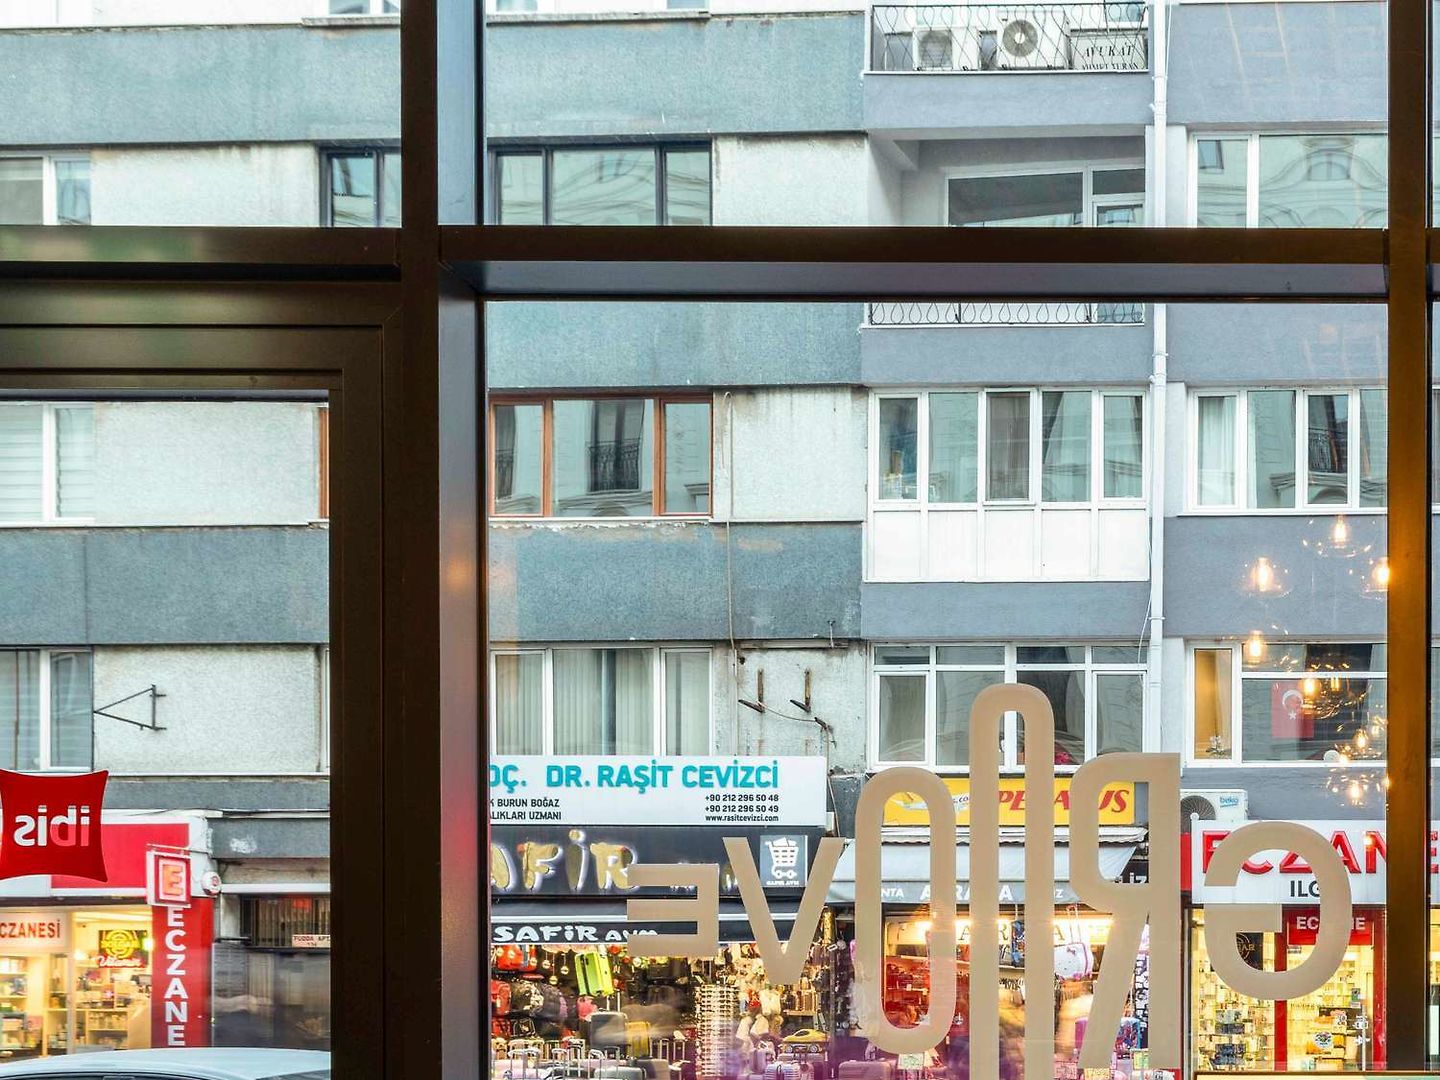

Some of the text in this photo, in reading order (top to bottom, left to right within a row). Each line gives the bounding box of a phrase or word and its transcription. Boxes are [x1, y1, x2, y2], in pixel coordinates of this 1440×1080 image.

[546, 765, 590, 788] DR.
[597, 759, 674, 794] RAŞİT
[681, 759, 778, 788] CEVİZCİ
[497, 799, 528, 808] BURUN
[530, 796, 560, 808] BOĞAZ
[705, 794, 779, 802] +90 212 296 50 48
[998, 790, 1129, 813] PEAS
[529, 811, 562, 820] UZMANI
[705, 814, 779, 822] www.rasitcevizci.com
[1296, 916, 1366, 931] ECE
[493, 925, 598, 942] SAFİR
[164, 906, 188, 1046] ECZANE
